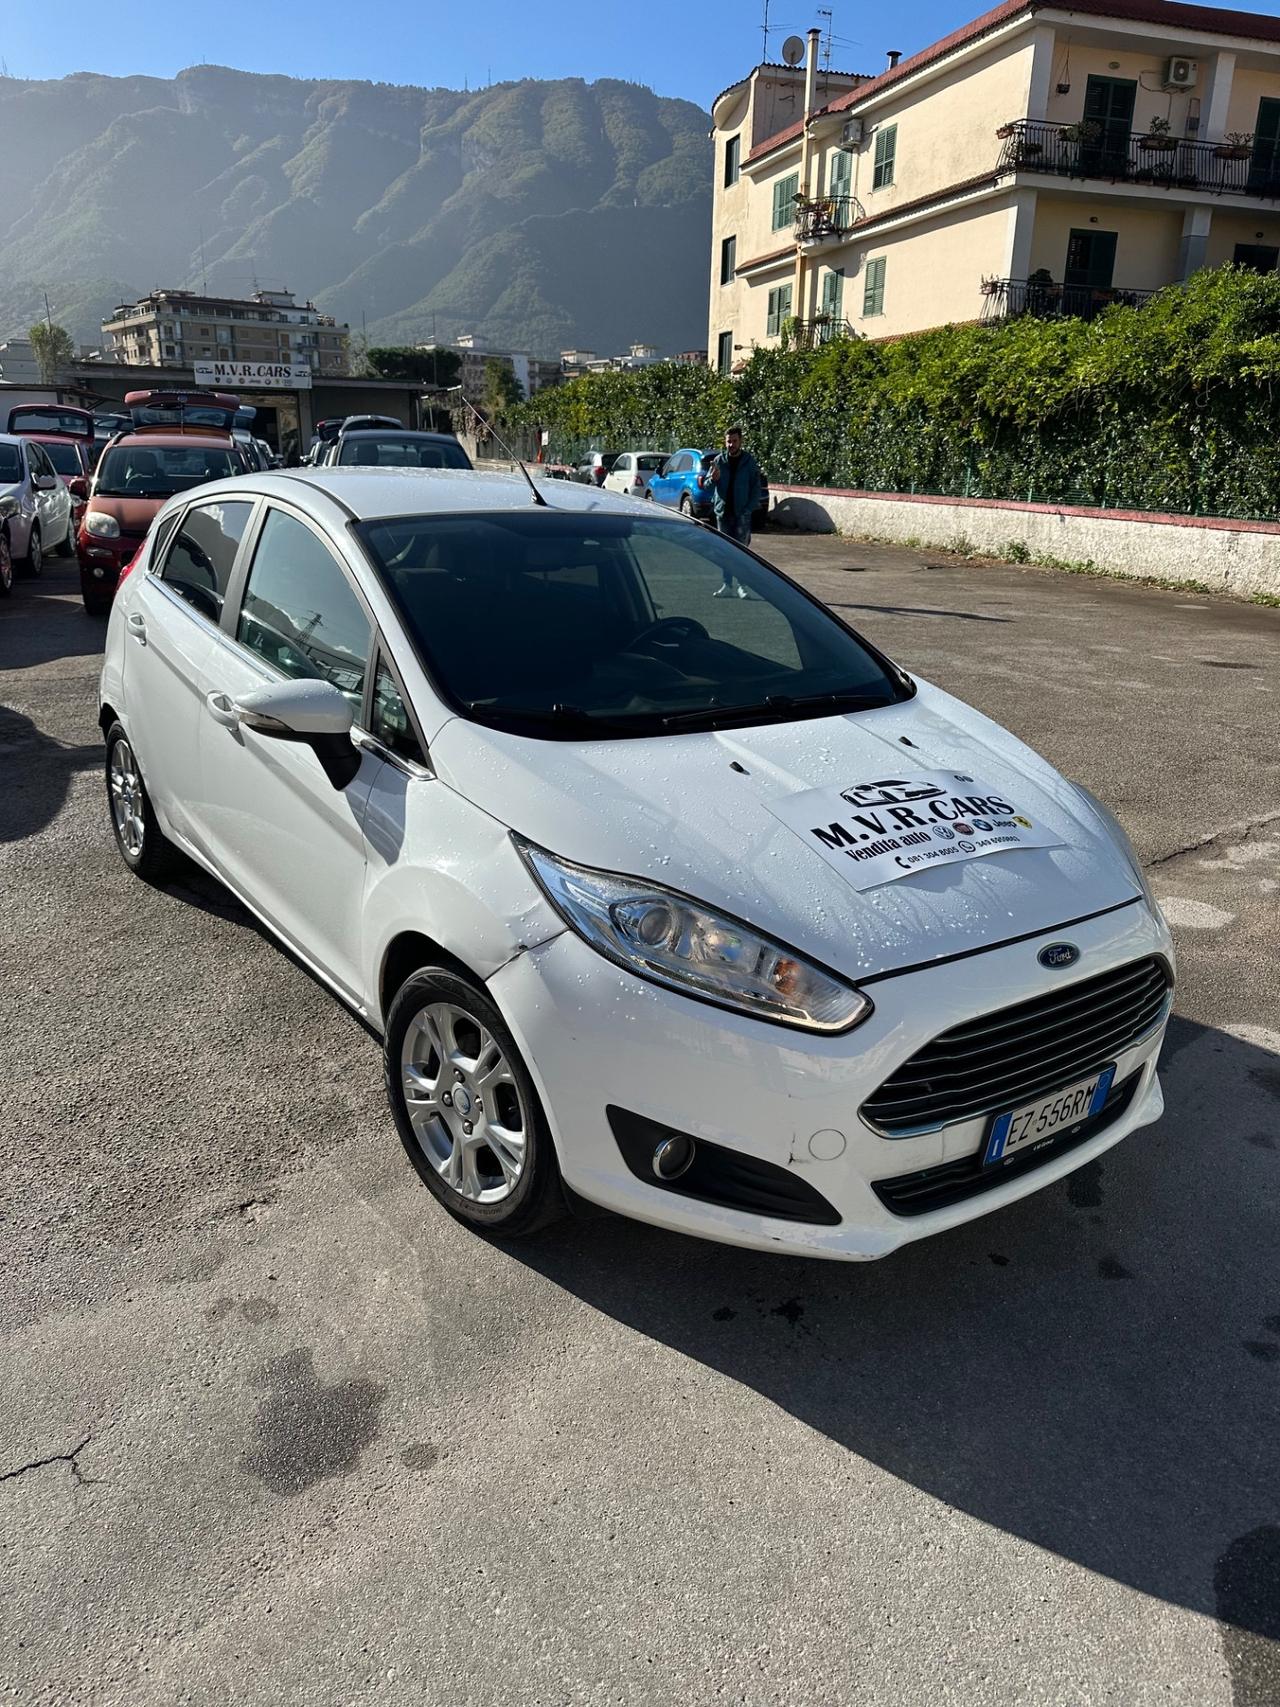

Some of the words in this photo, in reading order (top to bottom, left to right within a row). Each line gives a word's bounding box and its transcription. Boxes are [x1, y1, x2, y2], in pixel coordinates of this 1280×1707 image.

[845, 836, 900, 862] Vendita
[899, 831, 931, 847] auto
[1048, 947, 1072, 965] Ford
[1006, 1110, 1036, 1147] EZ
[1036, 1082, 1099, 1133] 556RM
